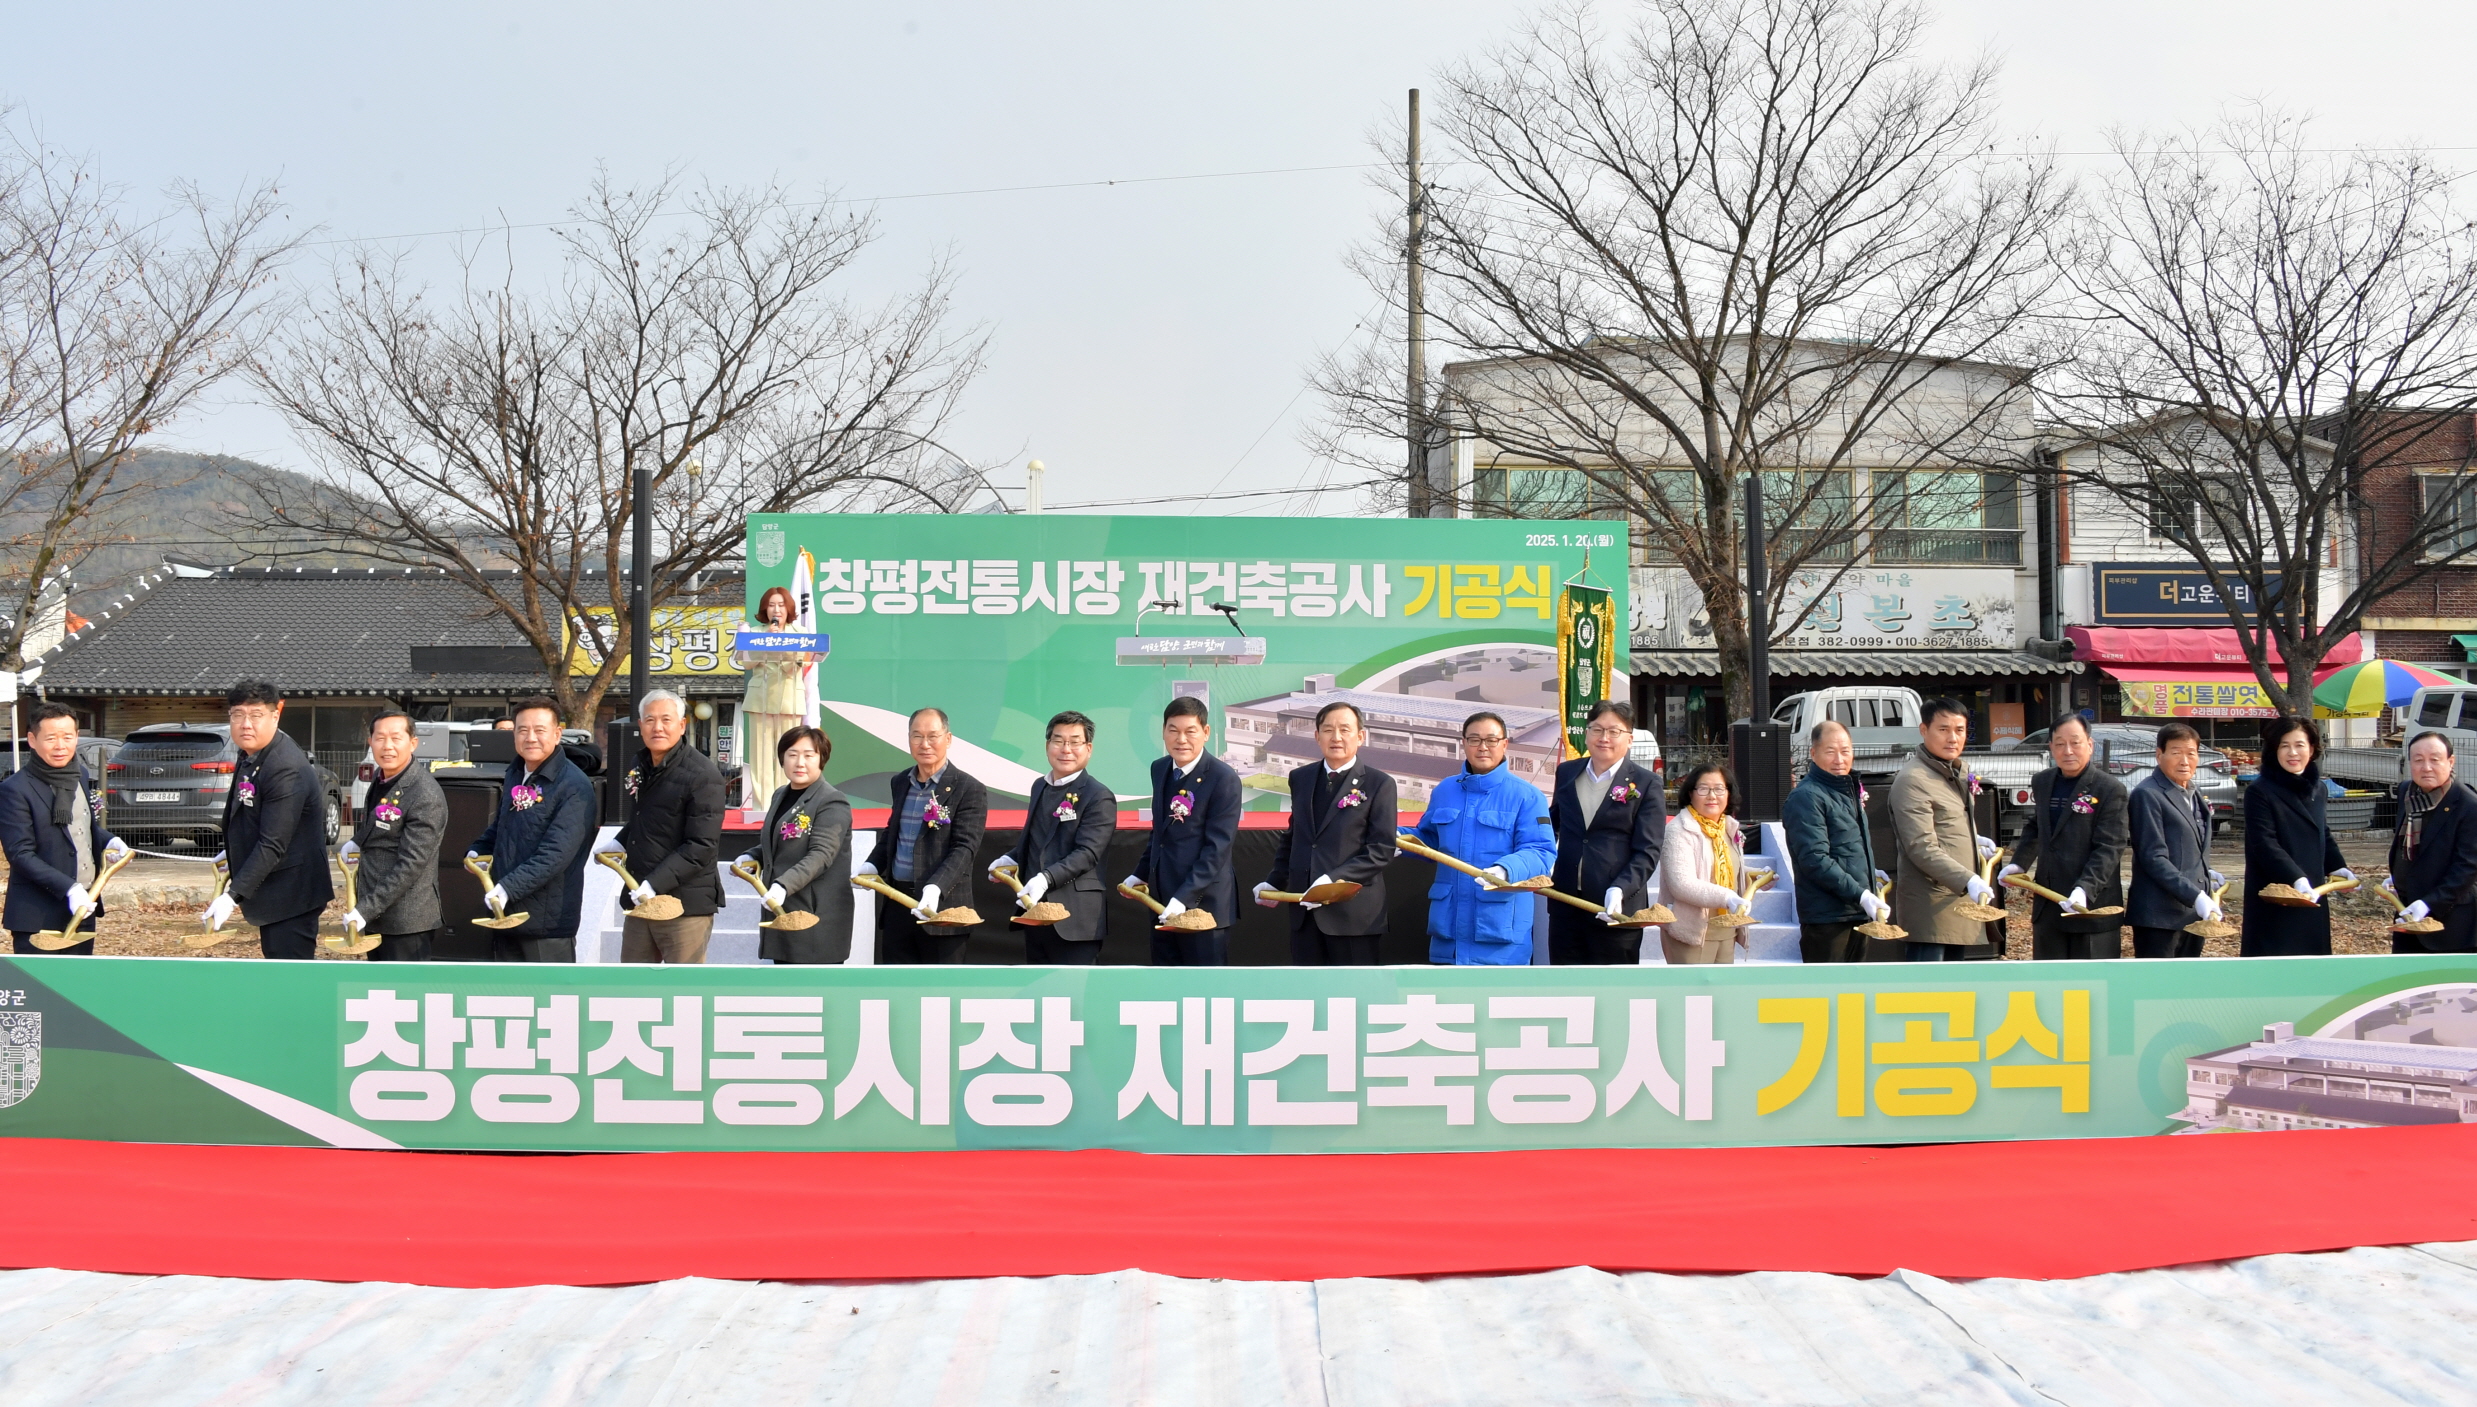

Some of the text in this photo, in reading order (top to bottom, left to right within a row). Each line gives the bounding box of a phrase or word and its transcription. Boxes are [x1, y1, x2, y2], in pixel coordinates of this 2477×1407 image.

[1525, 534, 1615, 547] 2025. 1. 20.(월)
[1876, 572, 1913, 587] 마을
[819, 558, 1551, 619] 창평전통시장 재건축공사 기공식
[1630, 635, 1659, 646] 1885
[1818, 636, 1884, 647] 382-0999
[1895, 636, 1989, 648] 010-3627-1885
[2153, 683, 2169, 715] 명품
[2230, 707, 2280, 718] 010-3575-74
[344, 989, 2090, 1126] 창평전통시장 재건축공사 기공식
